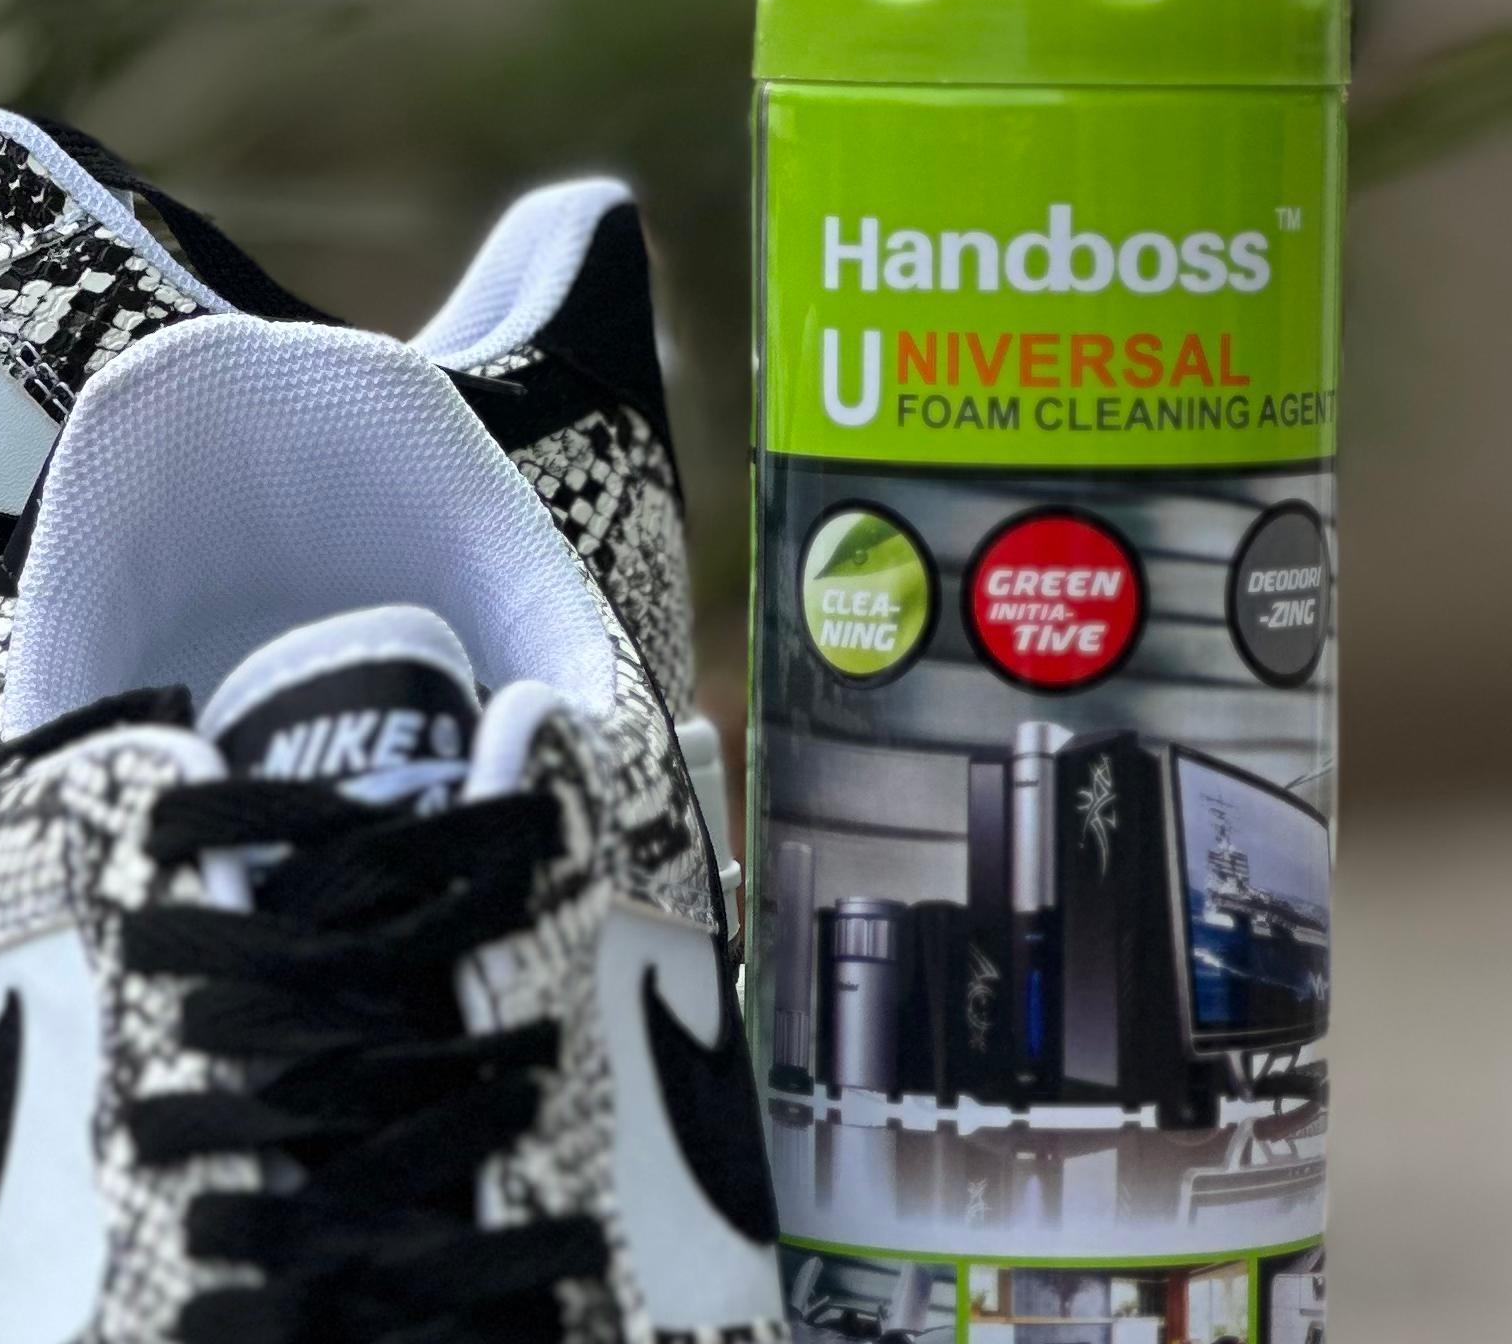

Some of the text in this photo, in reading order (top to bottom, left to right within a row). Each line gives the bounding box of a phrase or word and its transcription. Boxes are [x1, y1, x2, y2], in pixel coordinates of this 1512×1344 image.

[824, 204, 1303, 294] Handboss TM
[897, 389, 1336, 433] FOAM CLEANING AGENT
[988, 570, 1123, 598] GREEN
[822, 588, 901, 618] CLEA-
[990, 603, 1074, 622] INITIA-
[820, 622, 897, 652] NING
[1014, 624, 1106, 654] TIVE
[262, 708, 429, 781] NIKE
